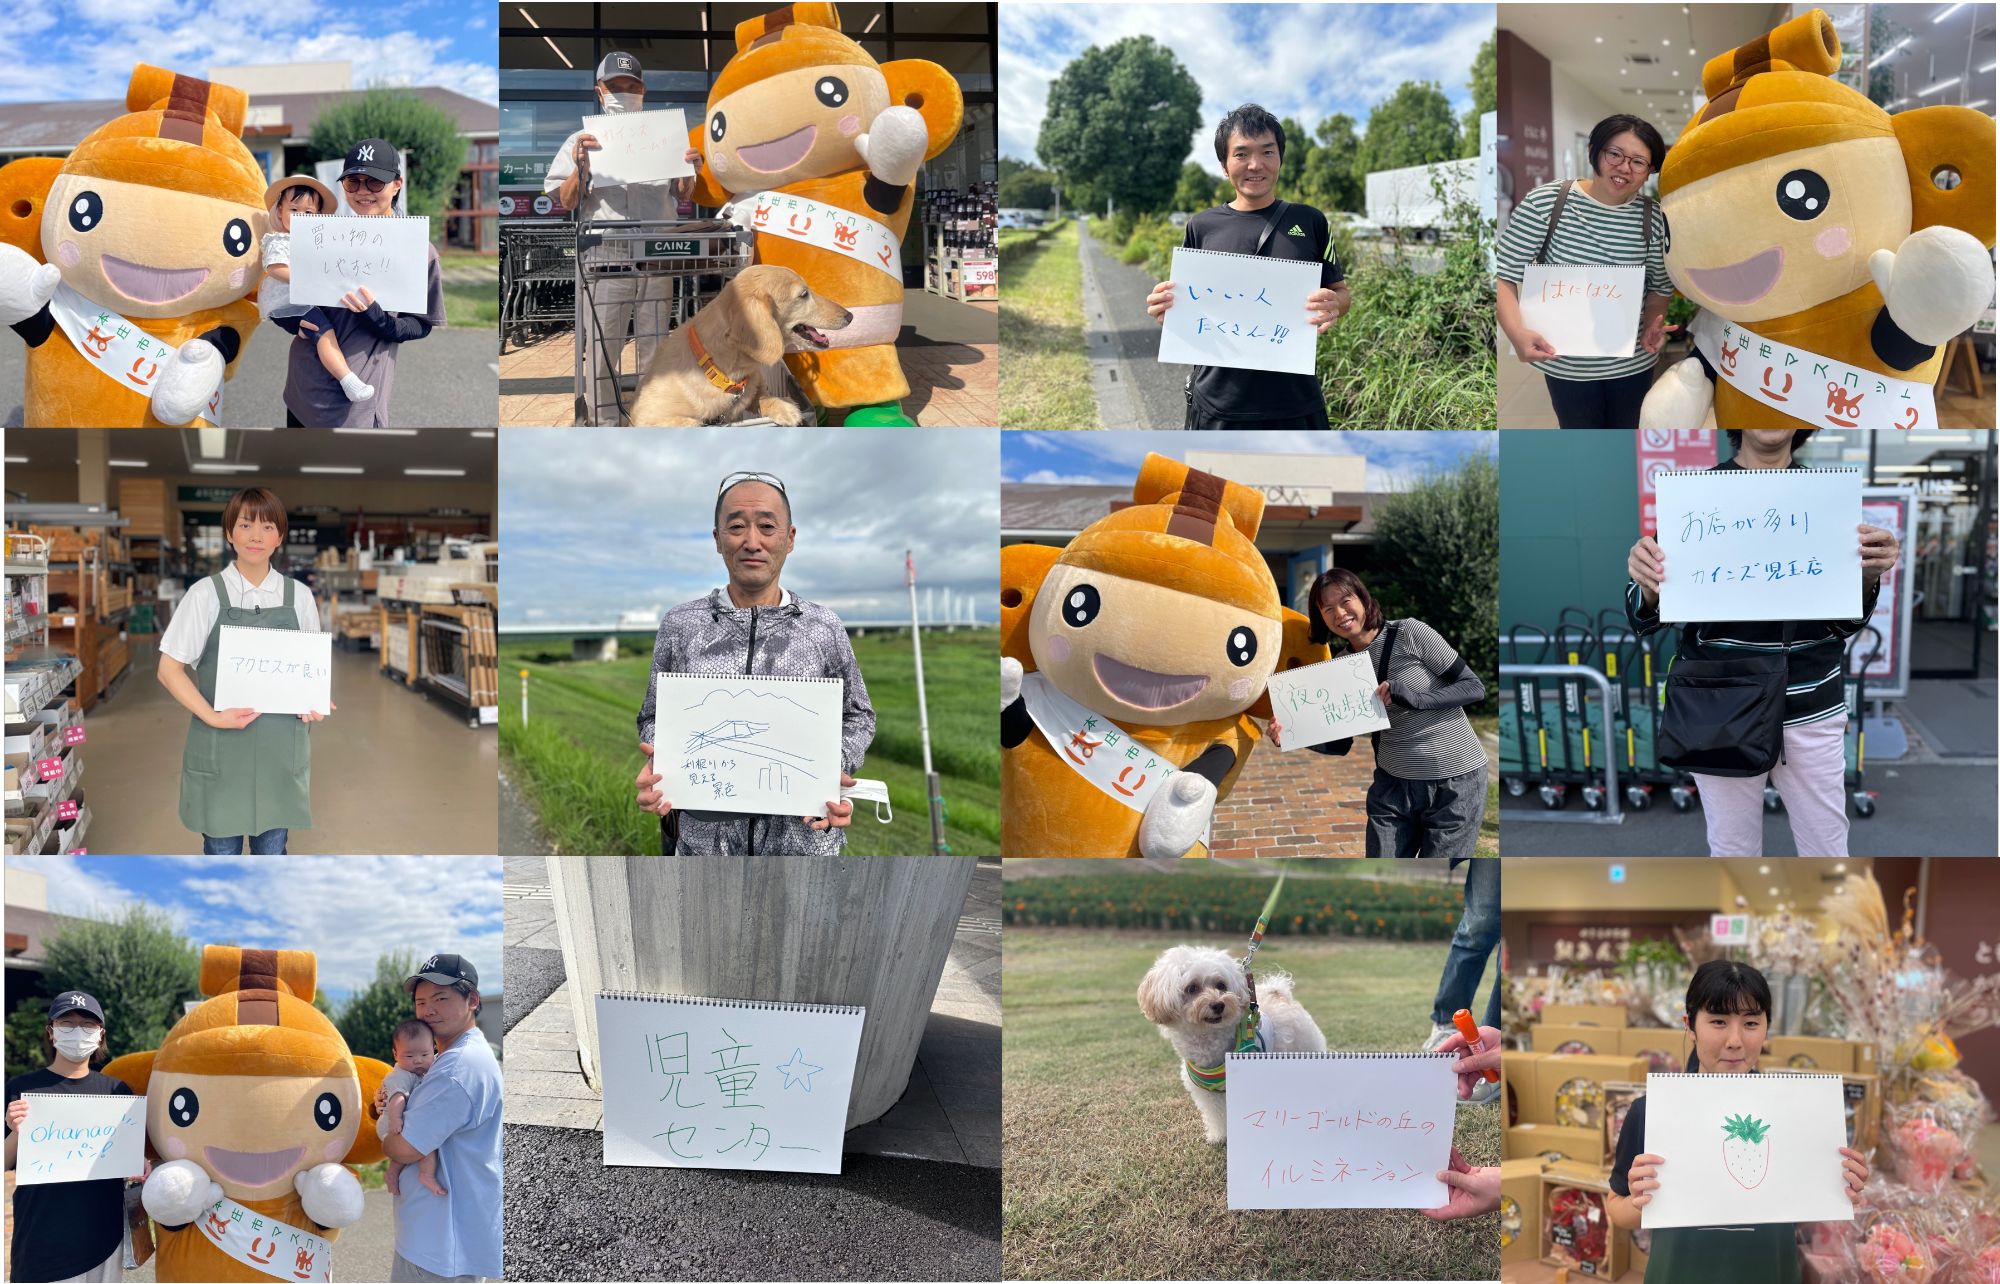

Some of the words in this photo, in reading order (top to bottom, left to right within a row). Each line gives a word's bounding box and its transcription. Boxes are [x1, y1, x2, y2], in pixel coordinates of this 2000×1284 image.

[356, 144, 375, 161] NY
[311, 223, 383, 250] 買い物の
[654, 241, 692, 251] CAINZ
[976, 270, 995, 281] 598
[1188, 285, 1273, 307] いい人
[1542, 279, 1622, 303] はにぽん
[1723, 324, 1912, 400] 本庄市マスコット
[230, 656, 327, 679] アクセスが良い
[1287, 683, 1330, 713] 夜の
[1319, 687, 1376, 726] 散歩道
[1520, 683, 1531, 713] CAINZ
[1565, 683, 1576, 713] CAINZ
[689, 772, 716, 787] 見える
[712, 781, 738, 801] 景色
[71, 995, 86, 1007] NY
[645, 1028, 765, 1109] 児童
[1243, 1110, 1435, 1136] マリーゴールドの丘の
[653, 1122, 821, 1162] センター
[1261, 1157, 1423, 1189] イルミネーション
